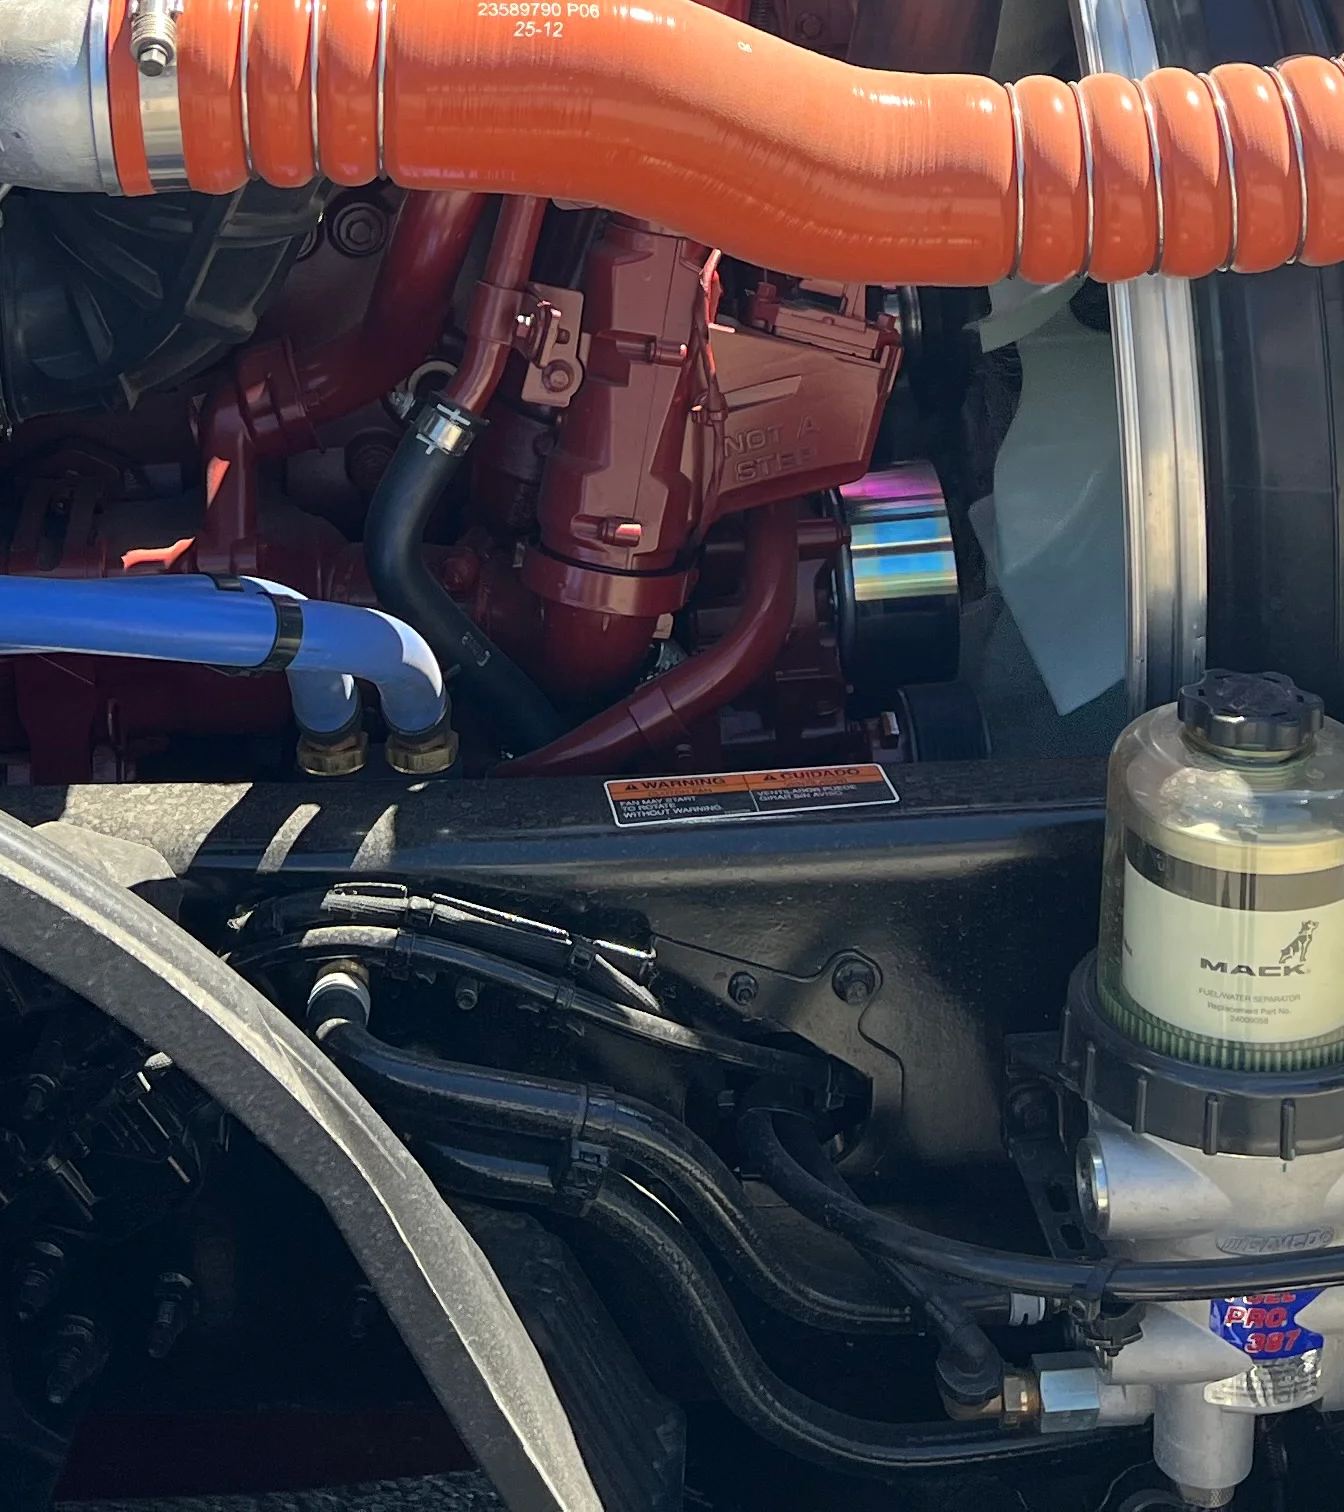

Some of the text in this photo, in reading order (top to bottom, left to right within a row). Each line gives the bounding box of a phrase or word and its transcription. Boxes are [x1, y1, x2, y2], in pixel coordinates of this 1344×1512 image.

[477, 2, 600, 19] 23589790 P06
[513, 21, 564, 38] 25-12
[724, 415, 822, 457] NOT A
[735, 445, 817, 482] STEP
[780, 768, 861, 780] CUIDADO
[641, 777, 726, 790] WARNING
[620, 799, 640, 807] FAN
[638, 802, 677, 811] ROTATE
[623, 809, 671, 819] WITHOUT
[1199, 956, 1307, 977] MACK
[1198, 987, 1302, 1003] FUEL/WATER SEPARATOR
[1260, 1007, 1277, 1015] Part
[1224, 1305, 1289, 1329] PRO
[1244, 1328, 1302, 1354] 387
